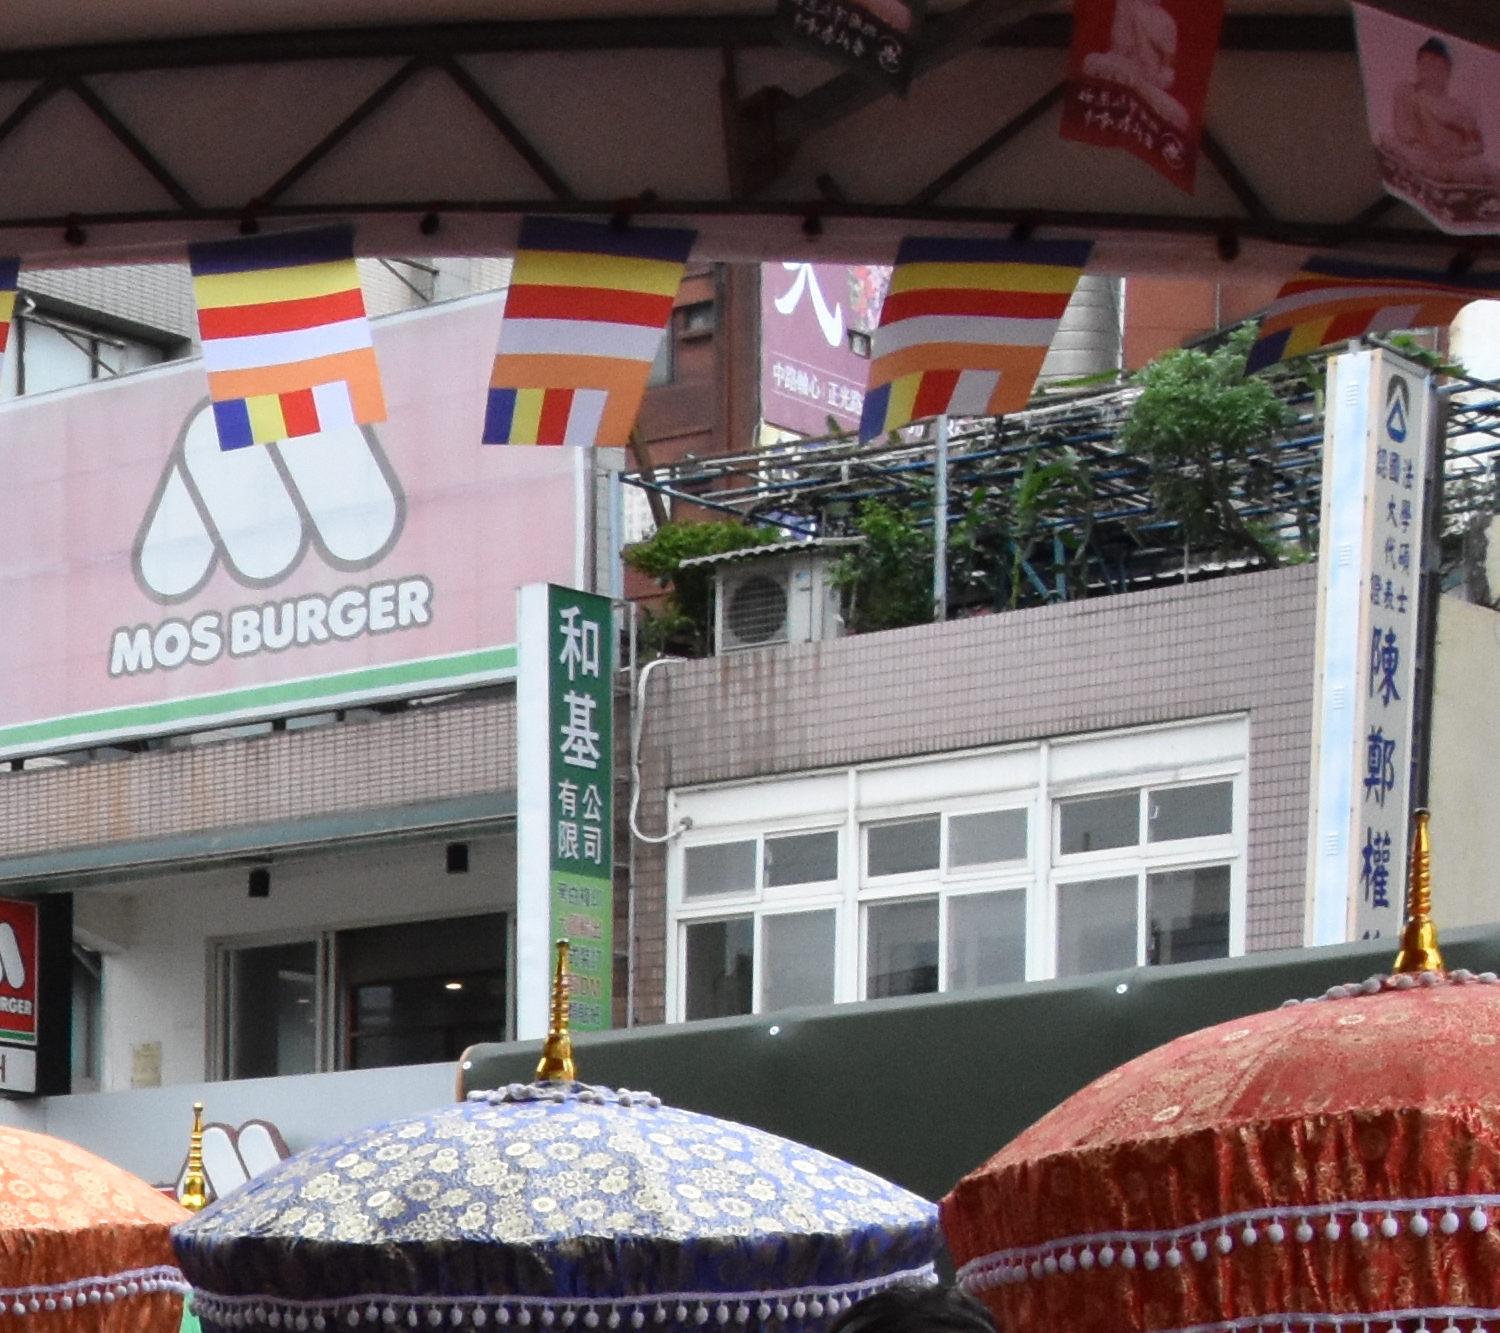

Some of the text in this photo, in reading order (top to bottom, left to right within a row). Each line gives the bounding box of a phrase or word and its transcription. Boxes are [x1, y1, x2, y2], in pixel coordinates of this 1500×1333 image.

[109, 576, 434, 678] MOS BURGER
[559, 606, 601, 769] 和基
[1360, 626, 1401, 941] 陳鄭權
